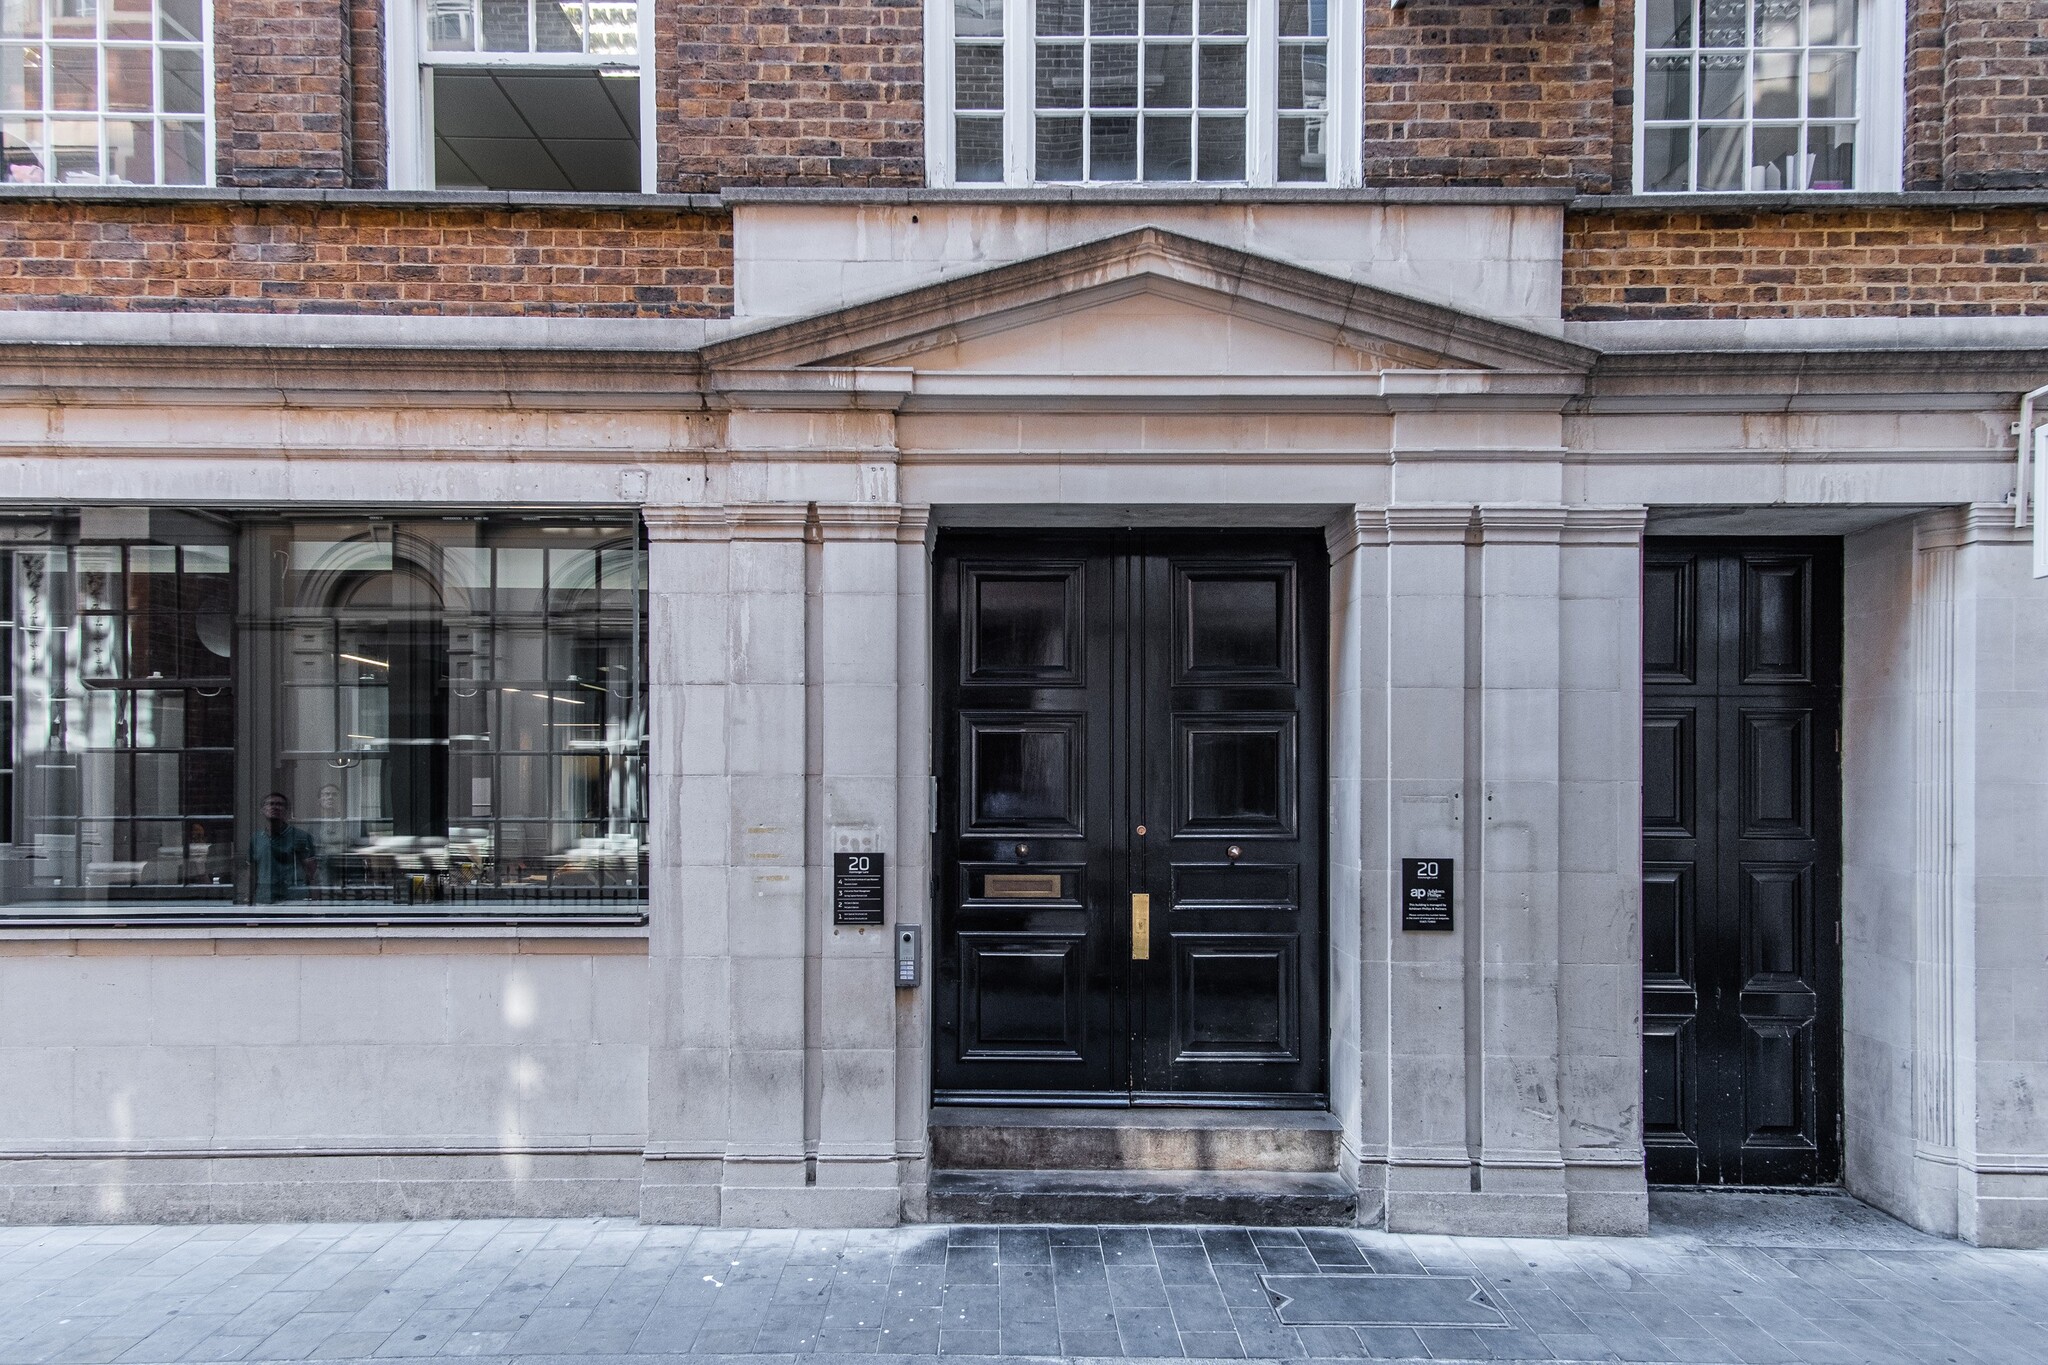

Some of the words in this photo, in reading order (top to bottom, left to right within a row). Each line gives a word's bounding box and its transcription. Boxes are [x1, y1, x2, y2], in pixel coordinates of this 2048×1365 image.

[849, 856, 869, 870] 20
[1418, 862, 1438, 876] 20
[1410, 888, 1426, 899] ap
